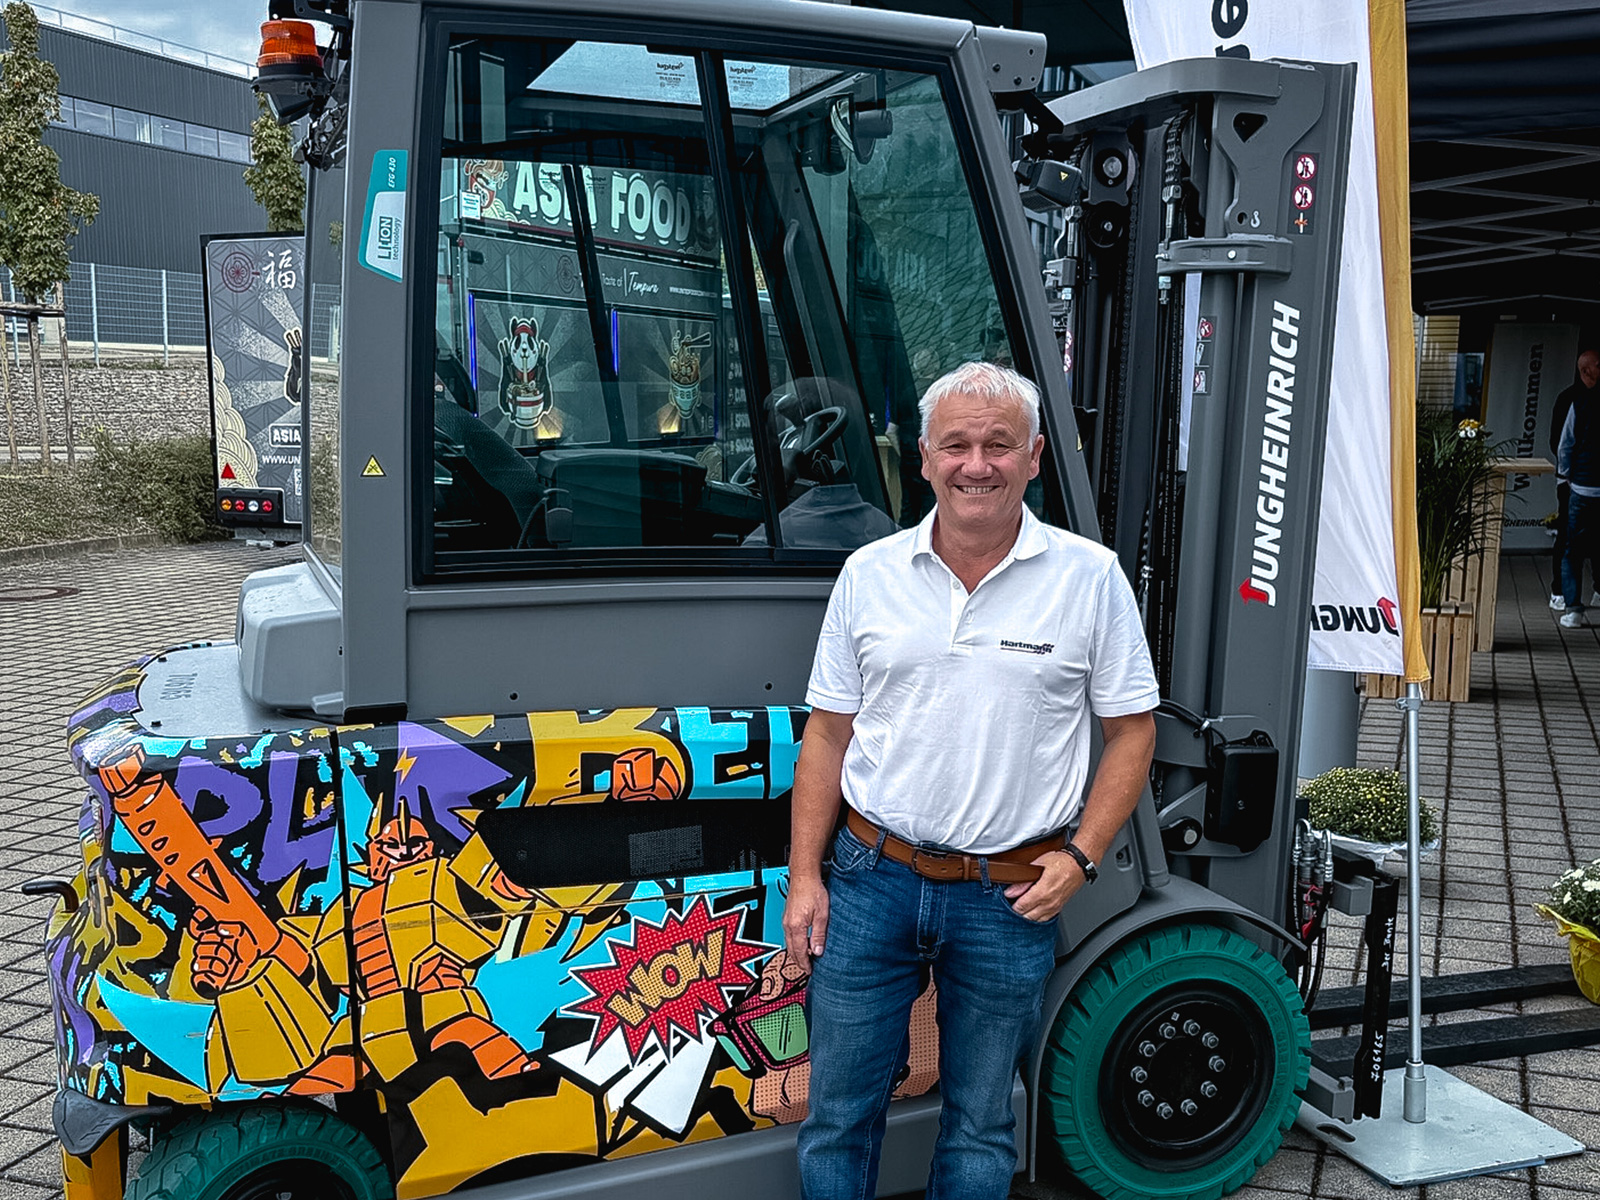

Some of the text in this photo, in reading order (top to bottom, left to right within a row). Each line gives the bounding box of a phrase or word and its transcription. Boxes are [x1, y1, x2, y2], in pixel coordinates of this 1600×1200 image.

[388, 157, 397, 188] EFG 430
[611, 170, 691, 242] FOOD
[392, 218, 402, 260] technology
[262, 249, 296, 290] 福
[272, 428, 302, 443] ASIA
[1513, 342, 1544, 493] Wllkommen
[261, 454, 301, 465] WWW.UN
[1240, 300, 1300, 607] JUNGHEINRICH
[1503, 517, 1546, 528] GHEINRIC
[1000, 639, 1053, 654] Hartmann
[607, 928, 726, 1027] WOW
[1370, 1030, 1384, 1083] 706165
